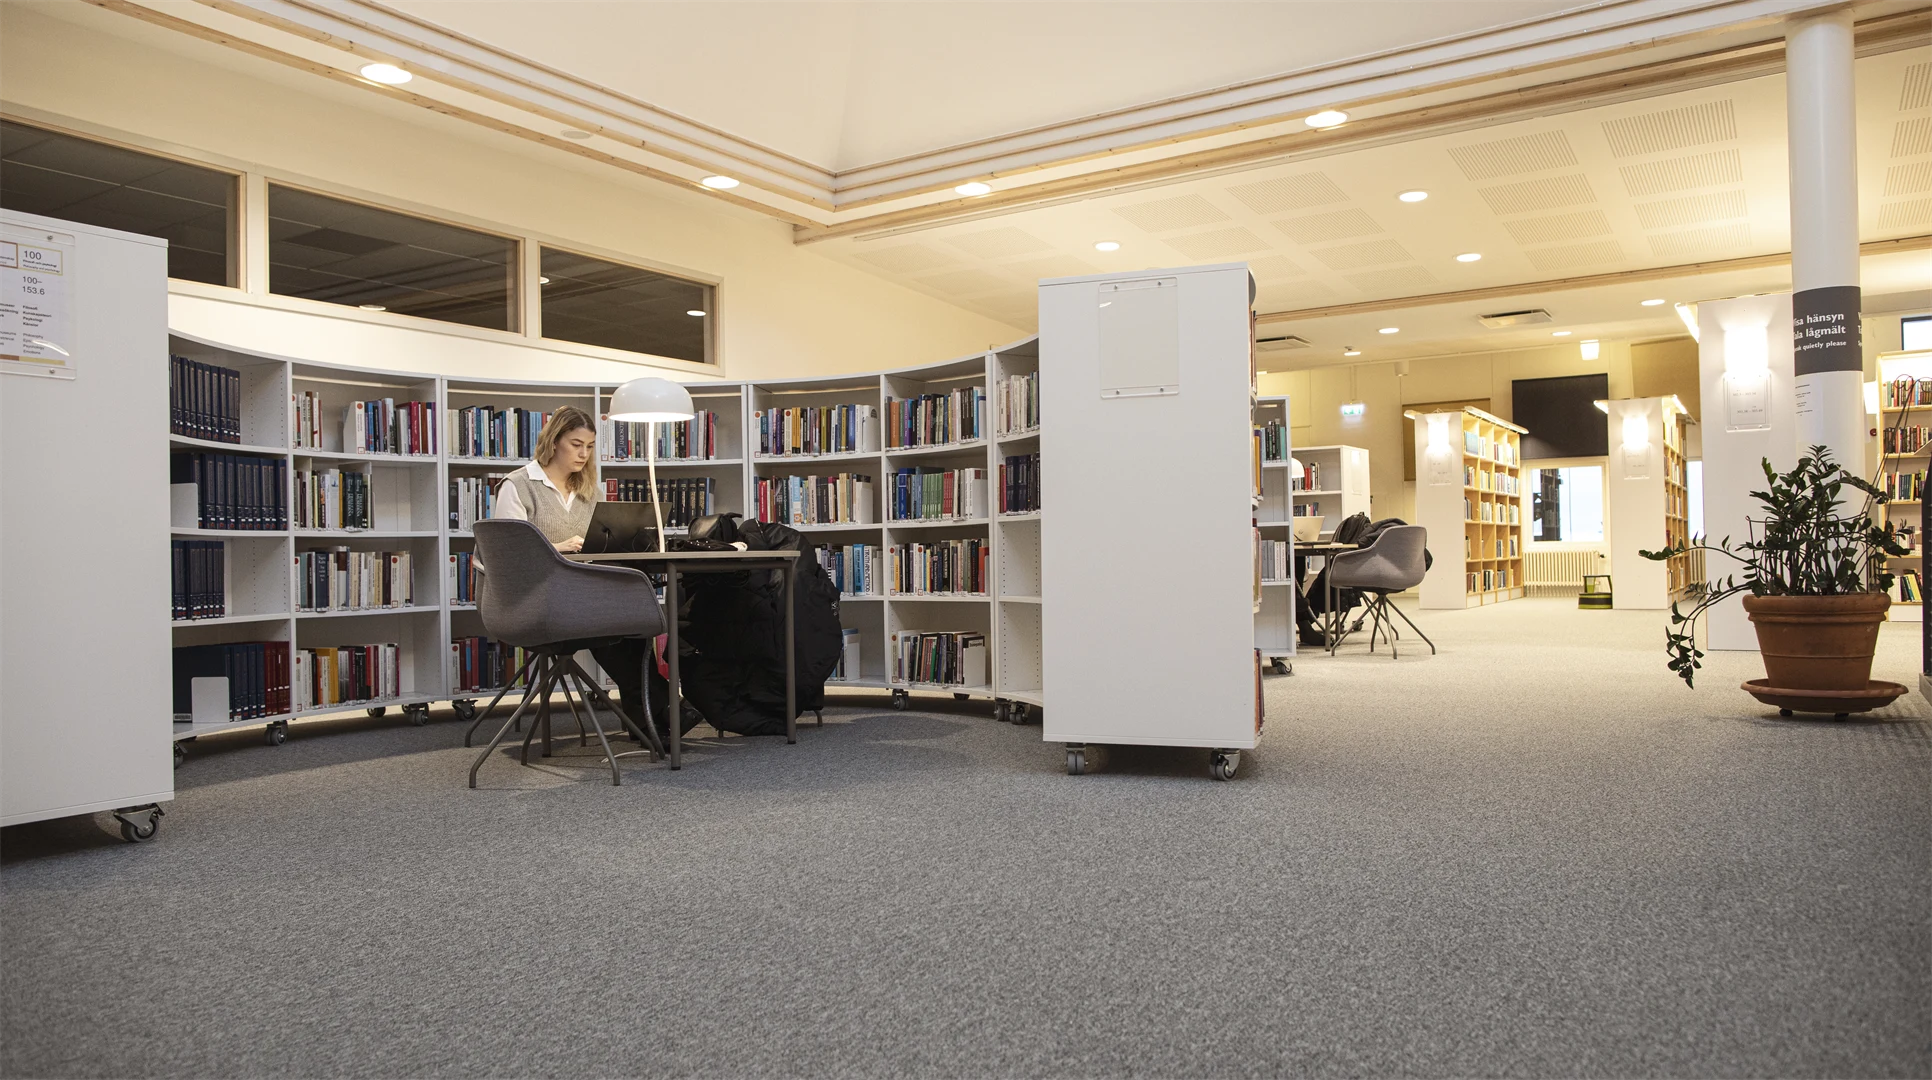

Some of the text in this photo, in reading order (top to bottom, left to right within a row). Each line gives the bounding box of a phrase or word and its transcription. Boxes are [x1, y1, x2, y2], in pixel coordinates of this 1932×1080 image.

[23, 250, 42, 261] 100
[22, 286, 45, 296] 153.6
[1806, 314, 1844, 324] hänsyn
[1805, 325, 1846, 338] lågmält
[1802, 342, 1823, 351] quietly
[1825, 340, 1846, 348] please
